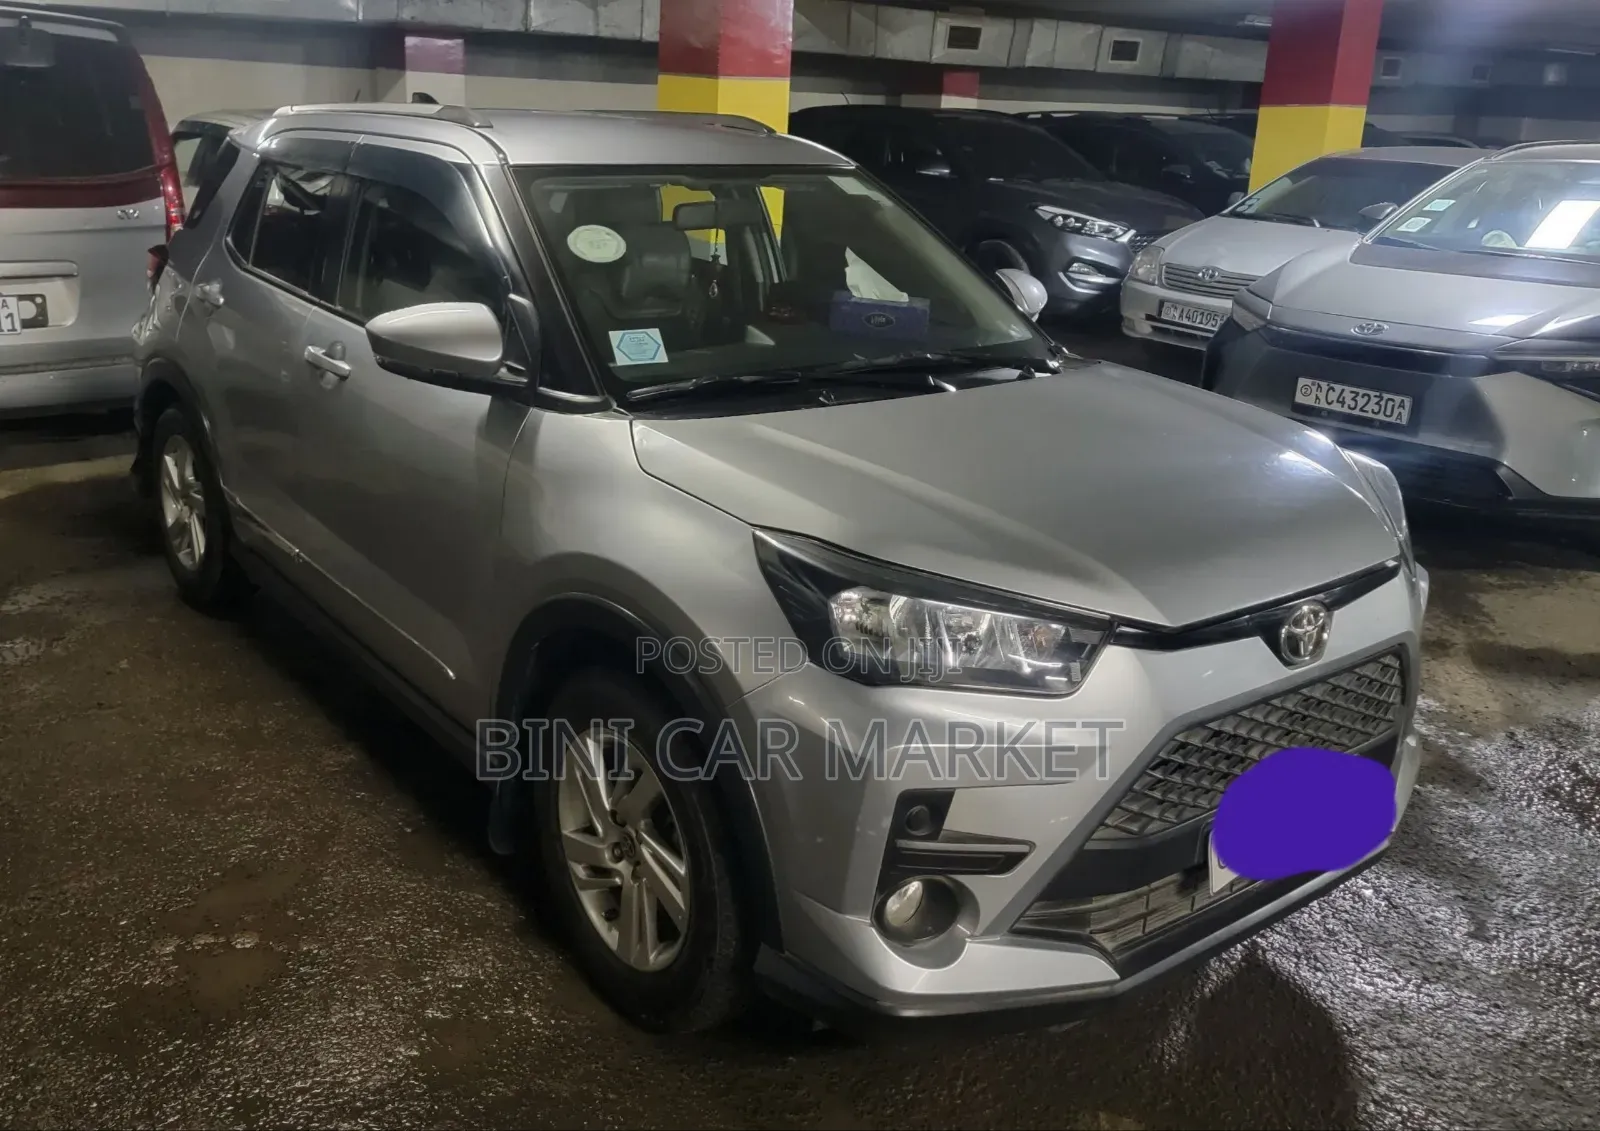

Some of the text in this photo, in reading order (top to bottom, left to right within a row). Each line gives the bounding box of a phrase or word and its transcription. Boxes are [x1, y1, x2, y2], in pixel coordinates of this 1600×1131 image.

[1, 299, 10, 310] A
[1178, 307, 1219, 328] A40195
[1325, 385, 1396, 418] C43230
[1397, 399, 1405, 410] A
[1395, 412, 1403, 423] A
